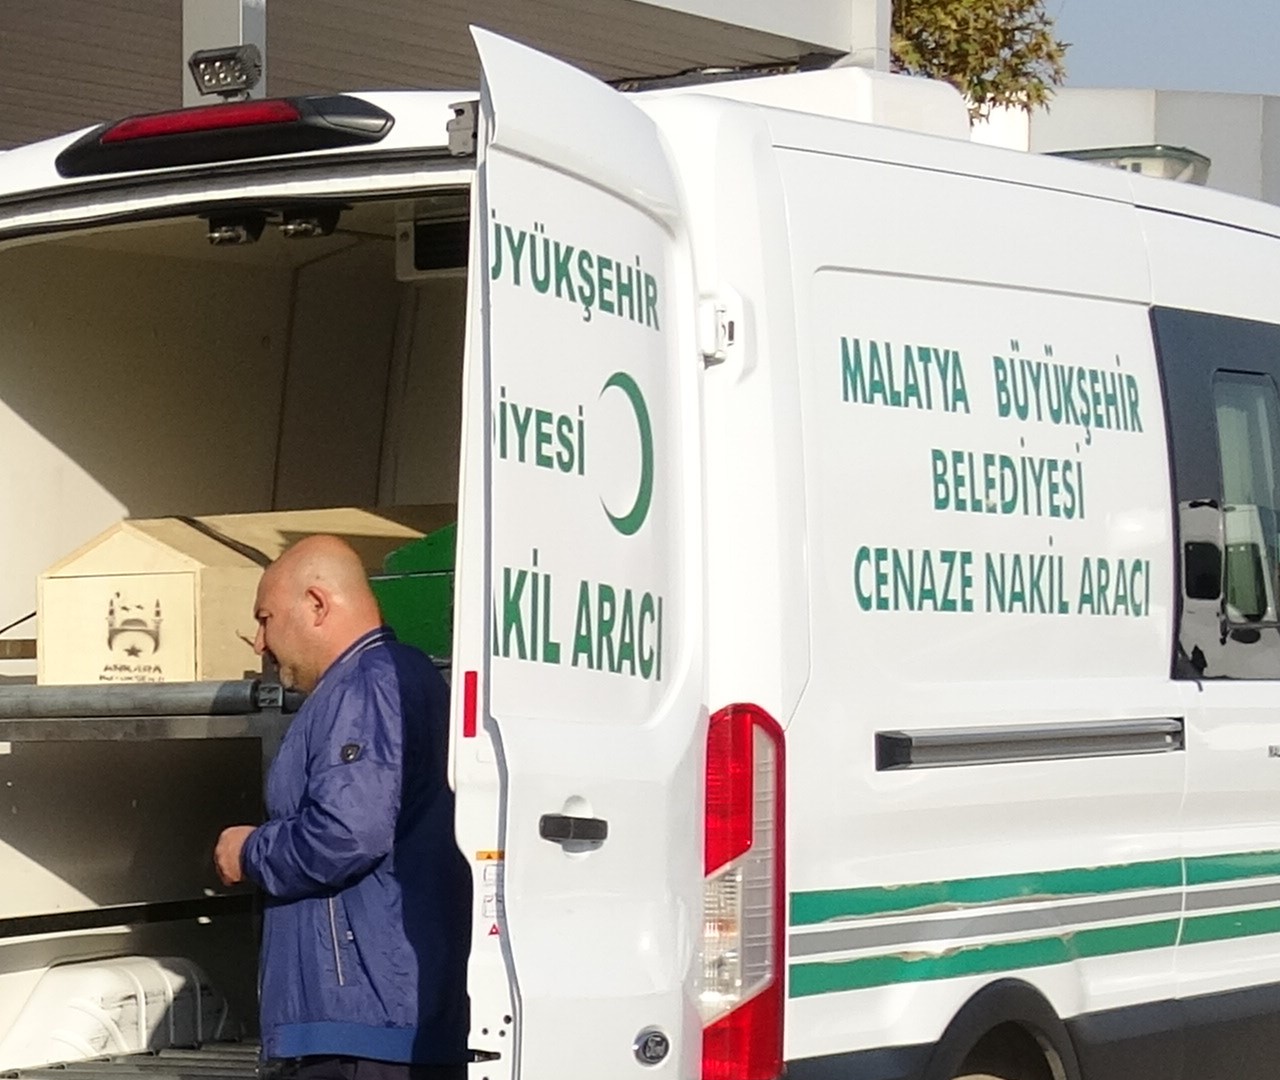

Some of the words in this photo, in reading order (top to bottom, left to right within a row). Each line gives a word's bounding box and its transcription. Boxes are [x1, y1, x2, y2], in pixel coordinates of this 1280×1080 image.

[492, 385, 585, 476] İYESİ
[840, 336, 971, 415] MALATYA
[992, 339, 1144, 446] BÜYÜKŞEHİR
[931, 436, 1086, 519] BELEDİYESİ
[492, 548, 561, 664] KİL
[571, 579, 662, 682] ARACI
[853, 546, 974, 612] CENAZE
[985, 535, 1070, 615] NAKİL
[1077, 557, 1150, 617] ARACI
